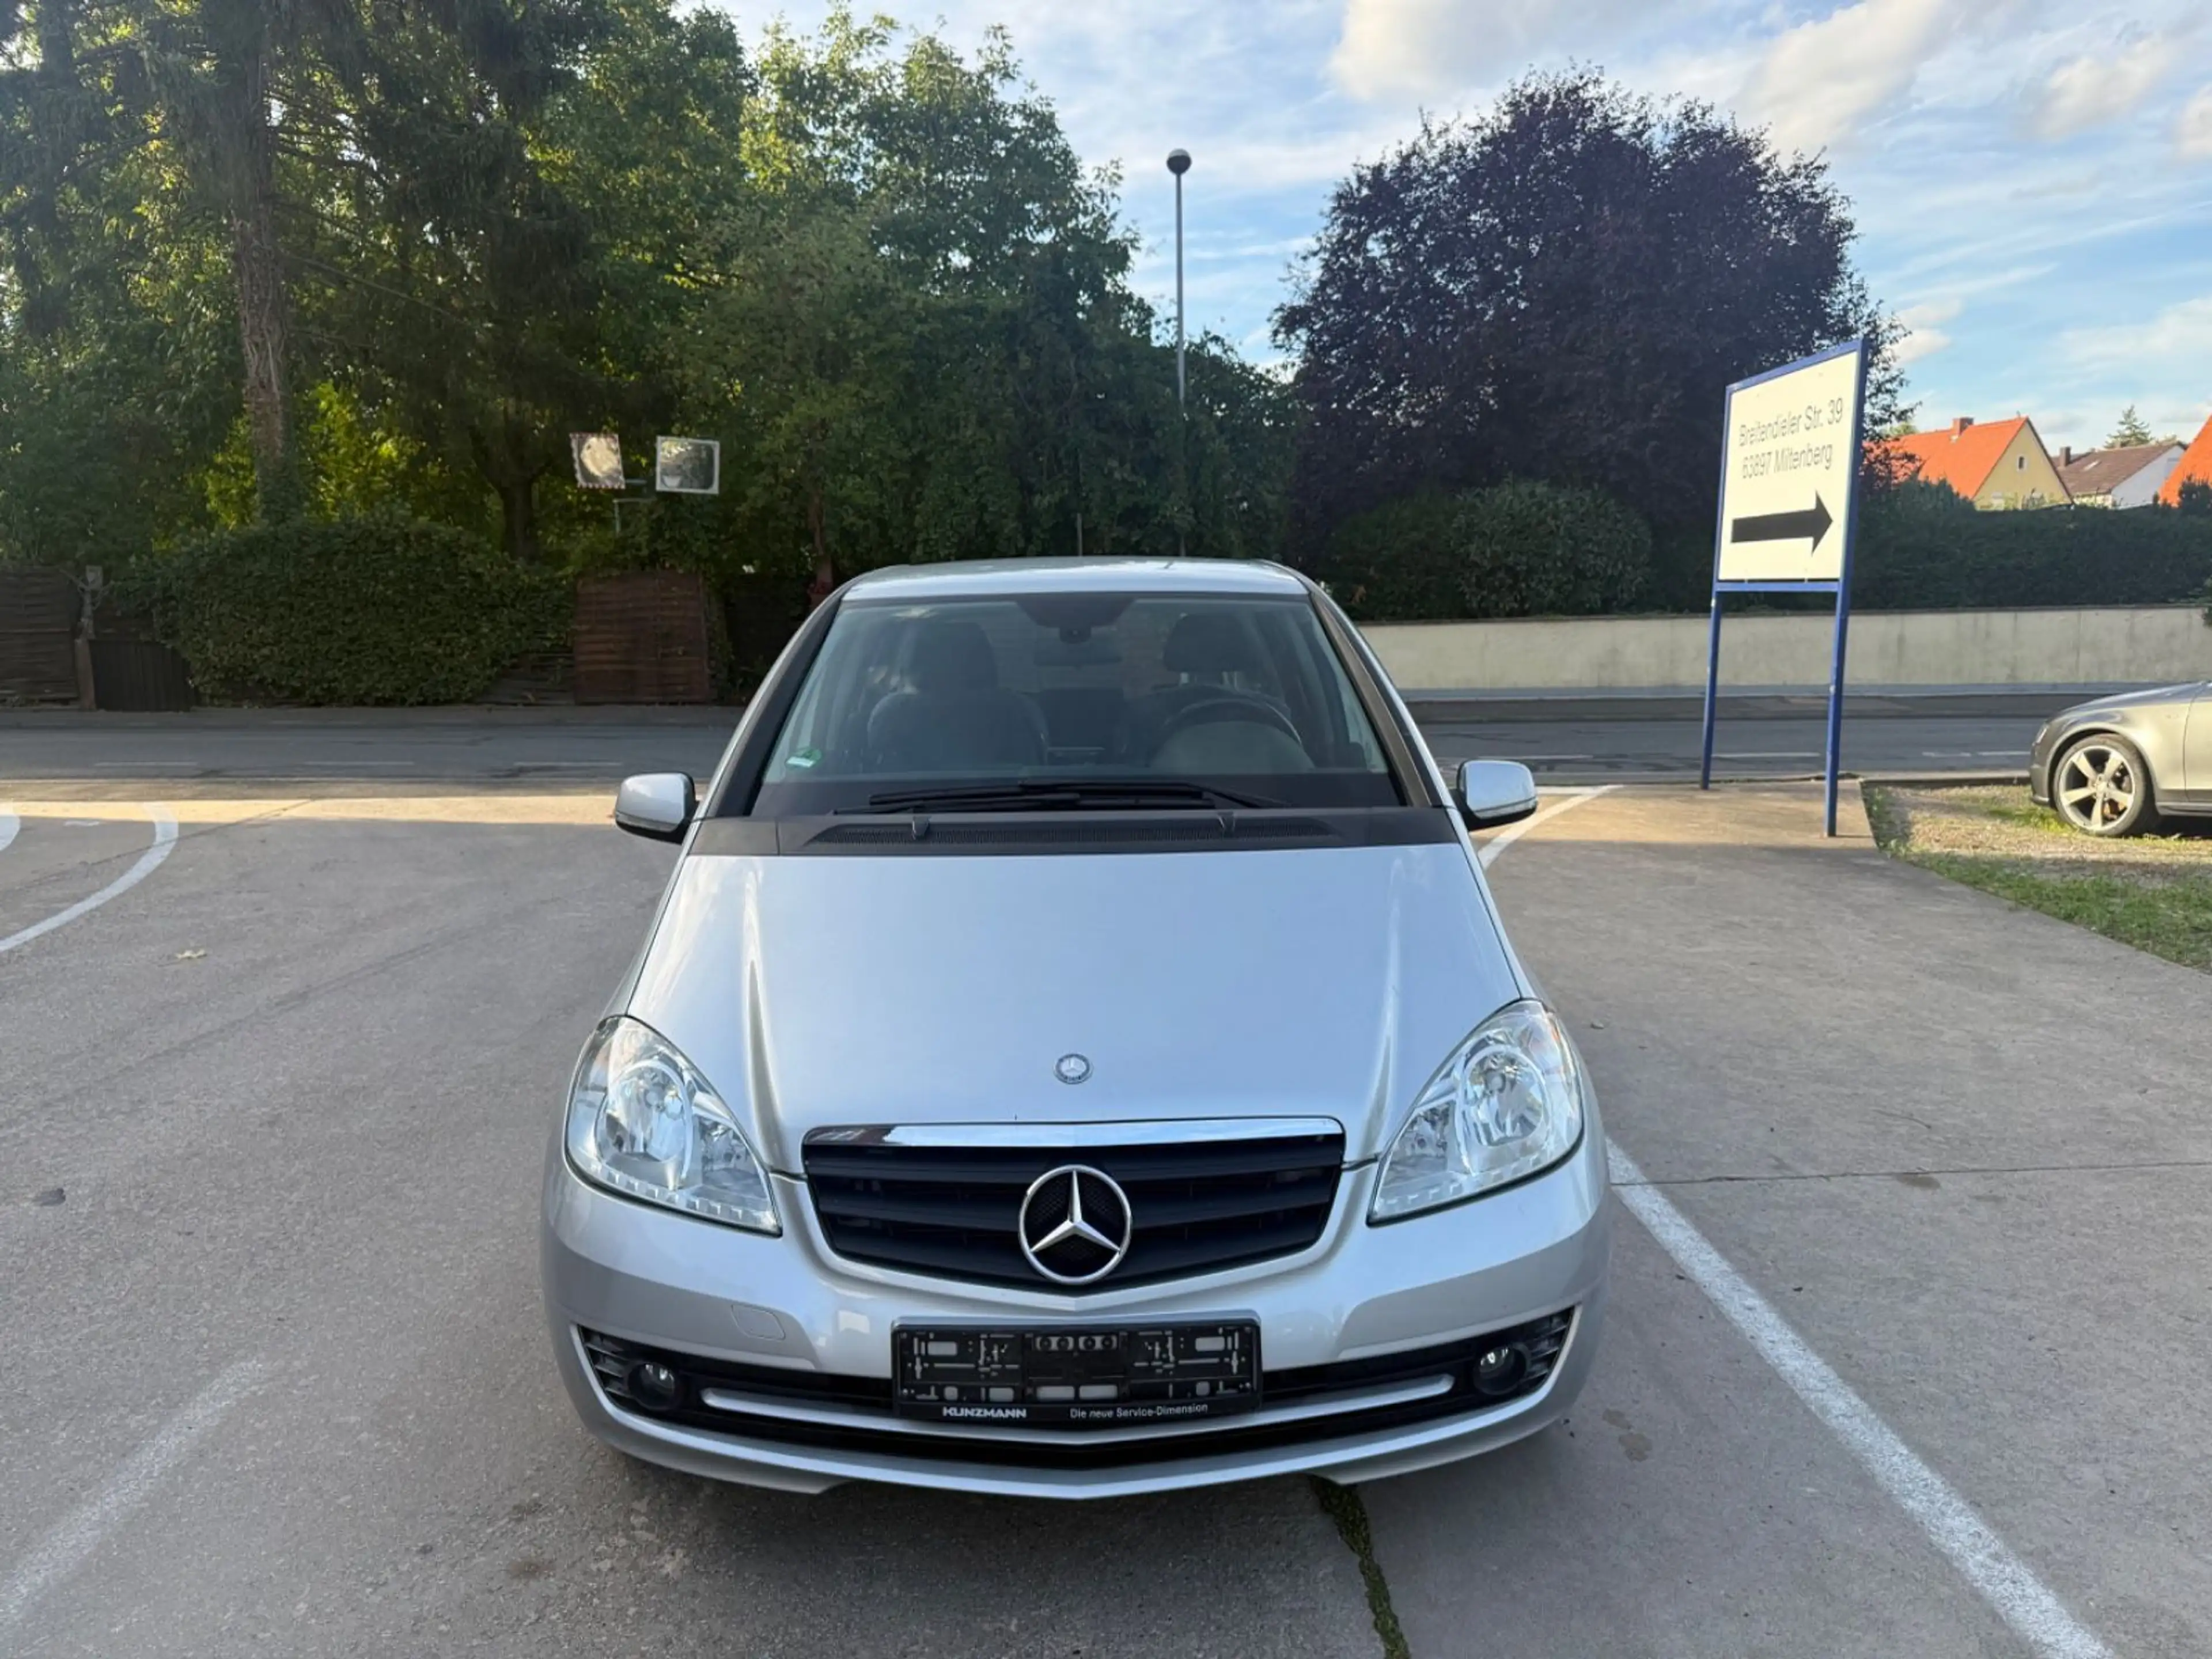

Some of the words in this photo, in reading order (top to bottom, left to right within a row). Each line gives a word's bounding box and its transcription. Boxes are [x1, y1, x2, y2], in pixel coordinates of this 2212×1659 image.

[1804, 404, 1824, 431] Str.
[1827, 397, 1843, 425] 39
[1774, 443, 1833, 472] Miltenberg
[942, 1406, 1028, 1418] KUNZMANN
[1070, 1407, 1087, 1418] Die
[1089, 1409, 1113, 1418] neue
[1116, 1403, 1208, 1417] Service-Dimension
